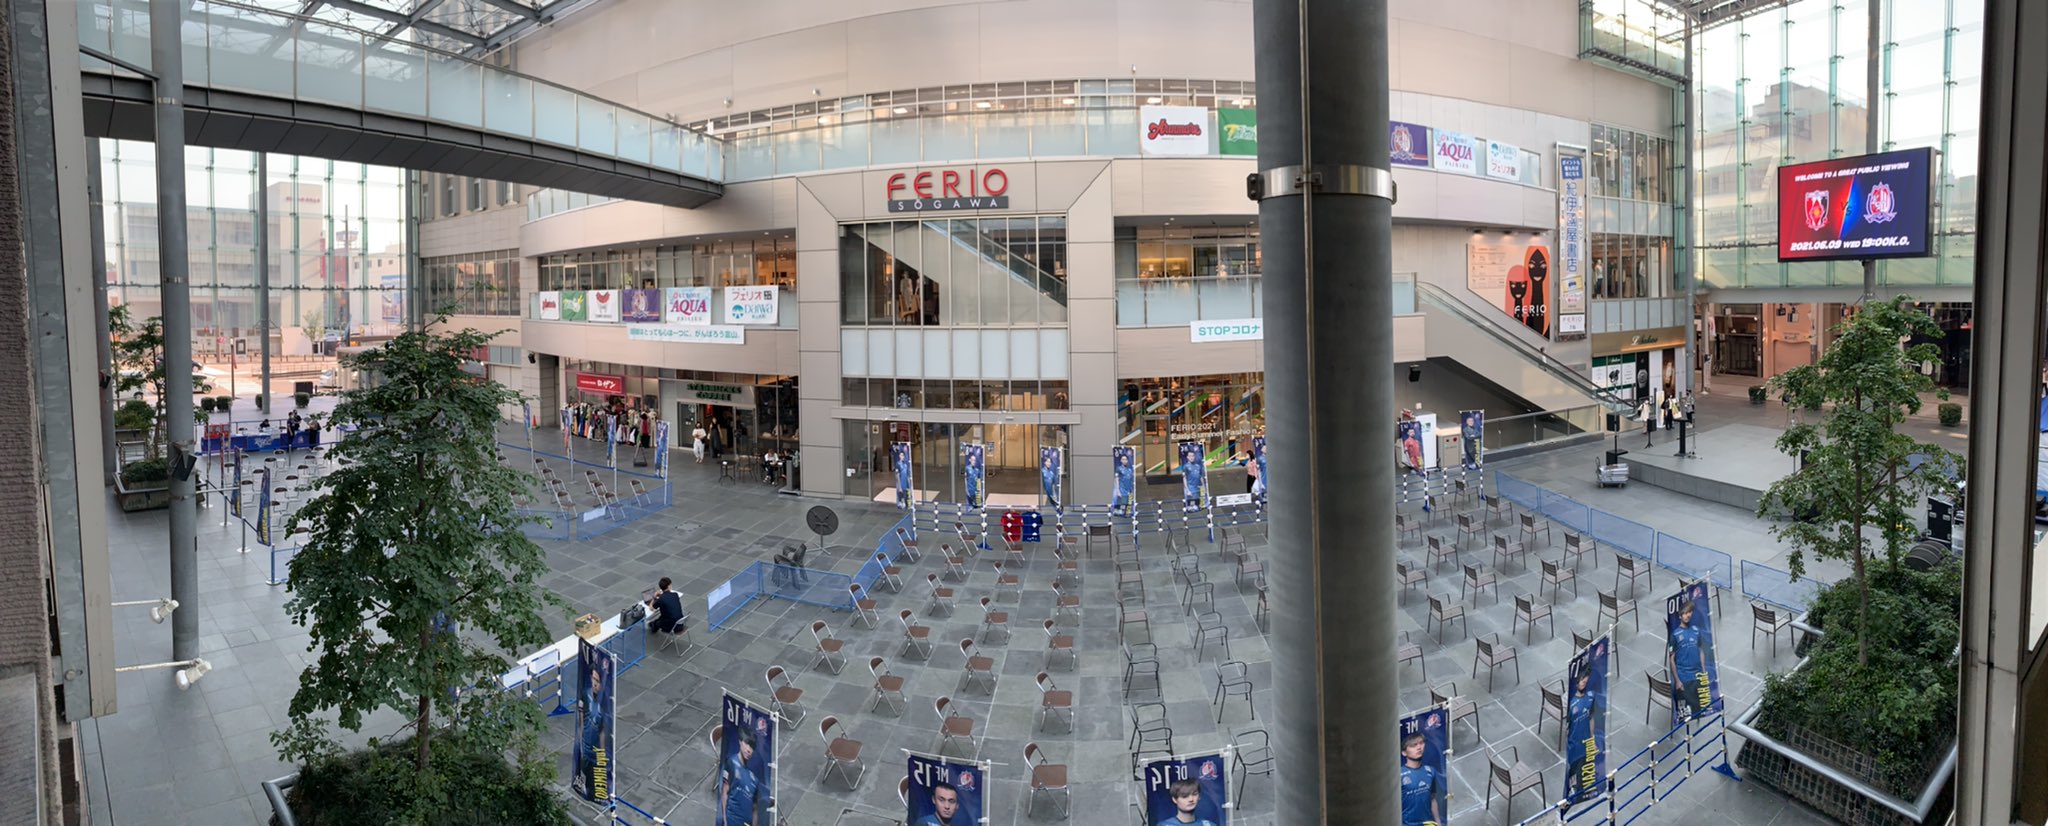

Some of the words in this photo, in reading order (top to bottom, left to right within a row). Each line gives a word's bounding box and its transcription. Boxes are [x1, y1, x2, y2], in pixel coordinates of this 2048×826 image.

[1437, 142, 1473, 161] AQUA
[1794, 172, 1823, 182] WELCOME
[1838, 168, 1857, 177] GREAT
[1857, 165, 1880, 174] PUBLIC
[1880, 162, 1910, 171] VIEWING
[886, 168, 1009, 201] FERIO
[1790, 239, 1842, 252] 2021.06.09
[732, 290, 763, 301] フェリオ
[670, 299, 708, 315] AQUA
[1514, 304, 1547, 315] FERIO
[686, 383, 742, 394] STARBUCKS
[695, 391, 732, 401] COFFEE
[1170, 423, 1196, 432] FERIO
[1197, 422, 1217, 430] 2021
[1225, 428, 1257, 436] Fashion
